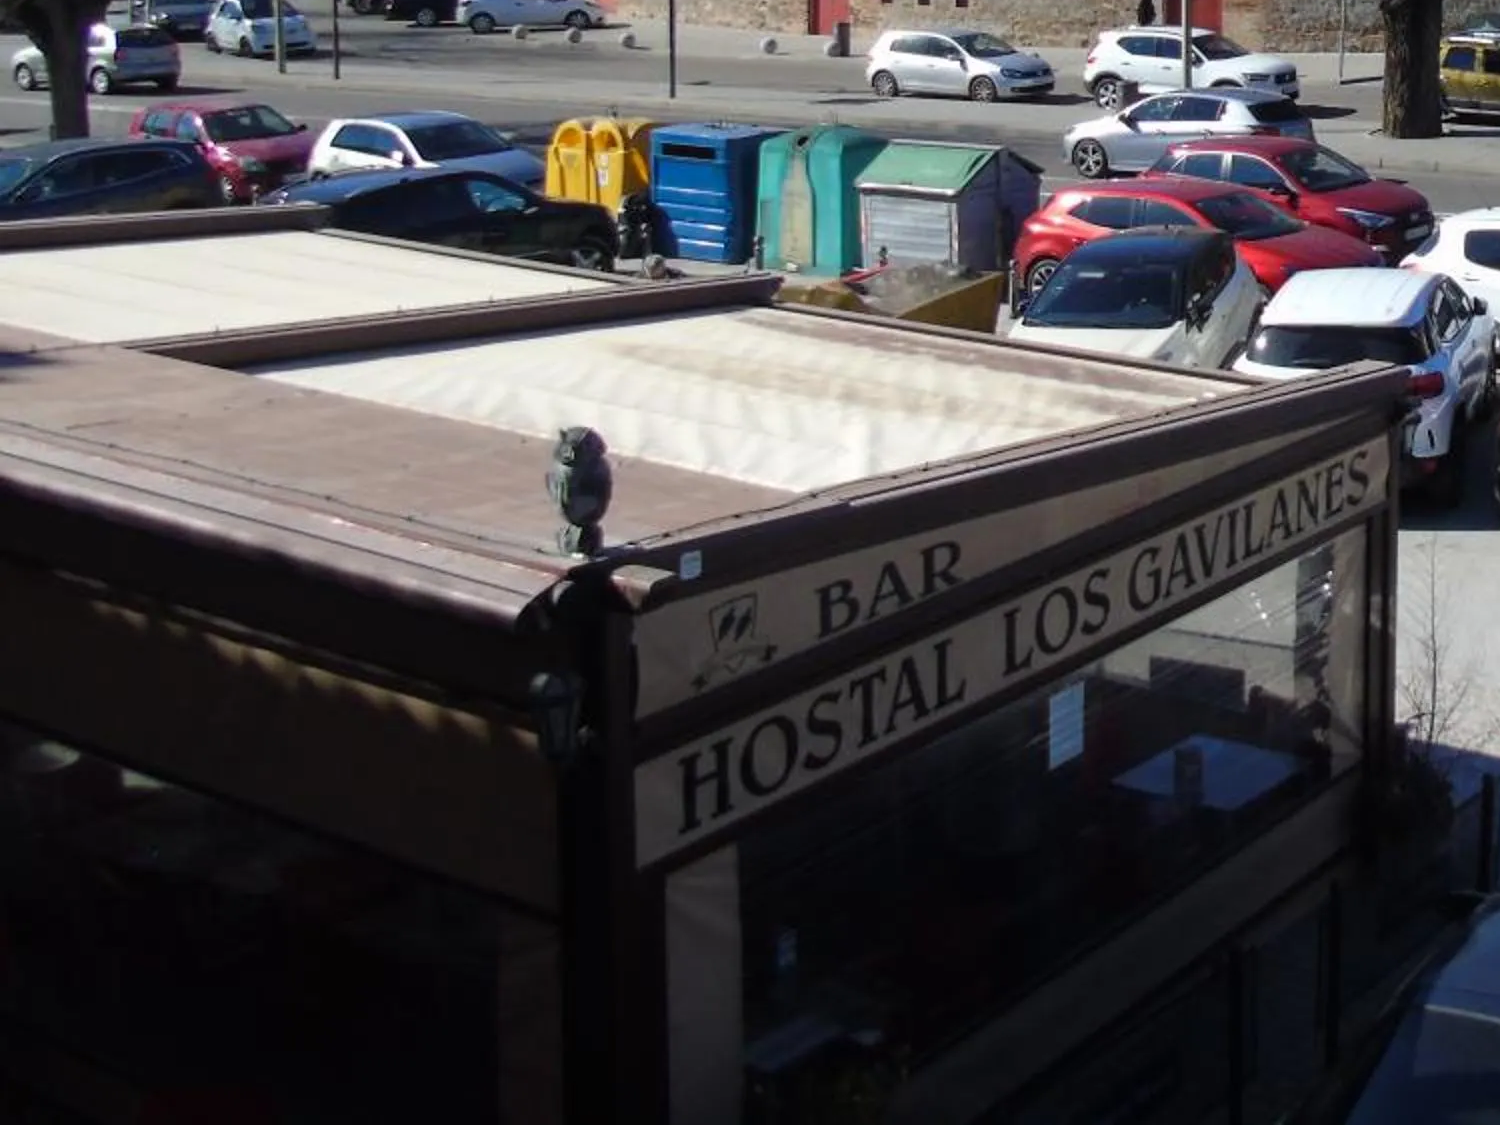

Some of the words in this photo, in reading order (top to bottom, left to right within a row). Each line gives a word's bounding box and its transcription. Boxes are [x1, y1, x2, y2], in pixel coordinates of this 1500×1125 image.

[678, 638, 967, 835] HOSTAL
[1003, 567, 1112, 676] LOS
[1127, 449, 1371, 611] GAVILANES
[815, 540, 965, 639] BAR
